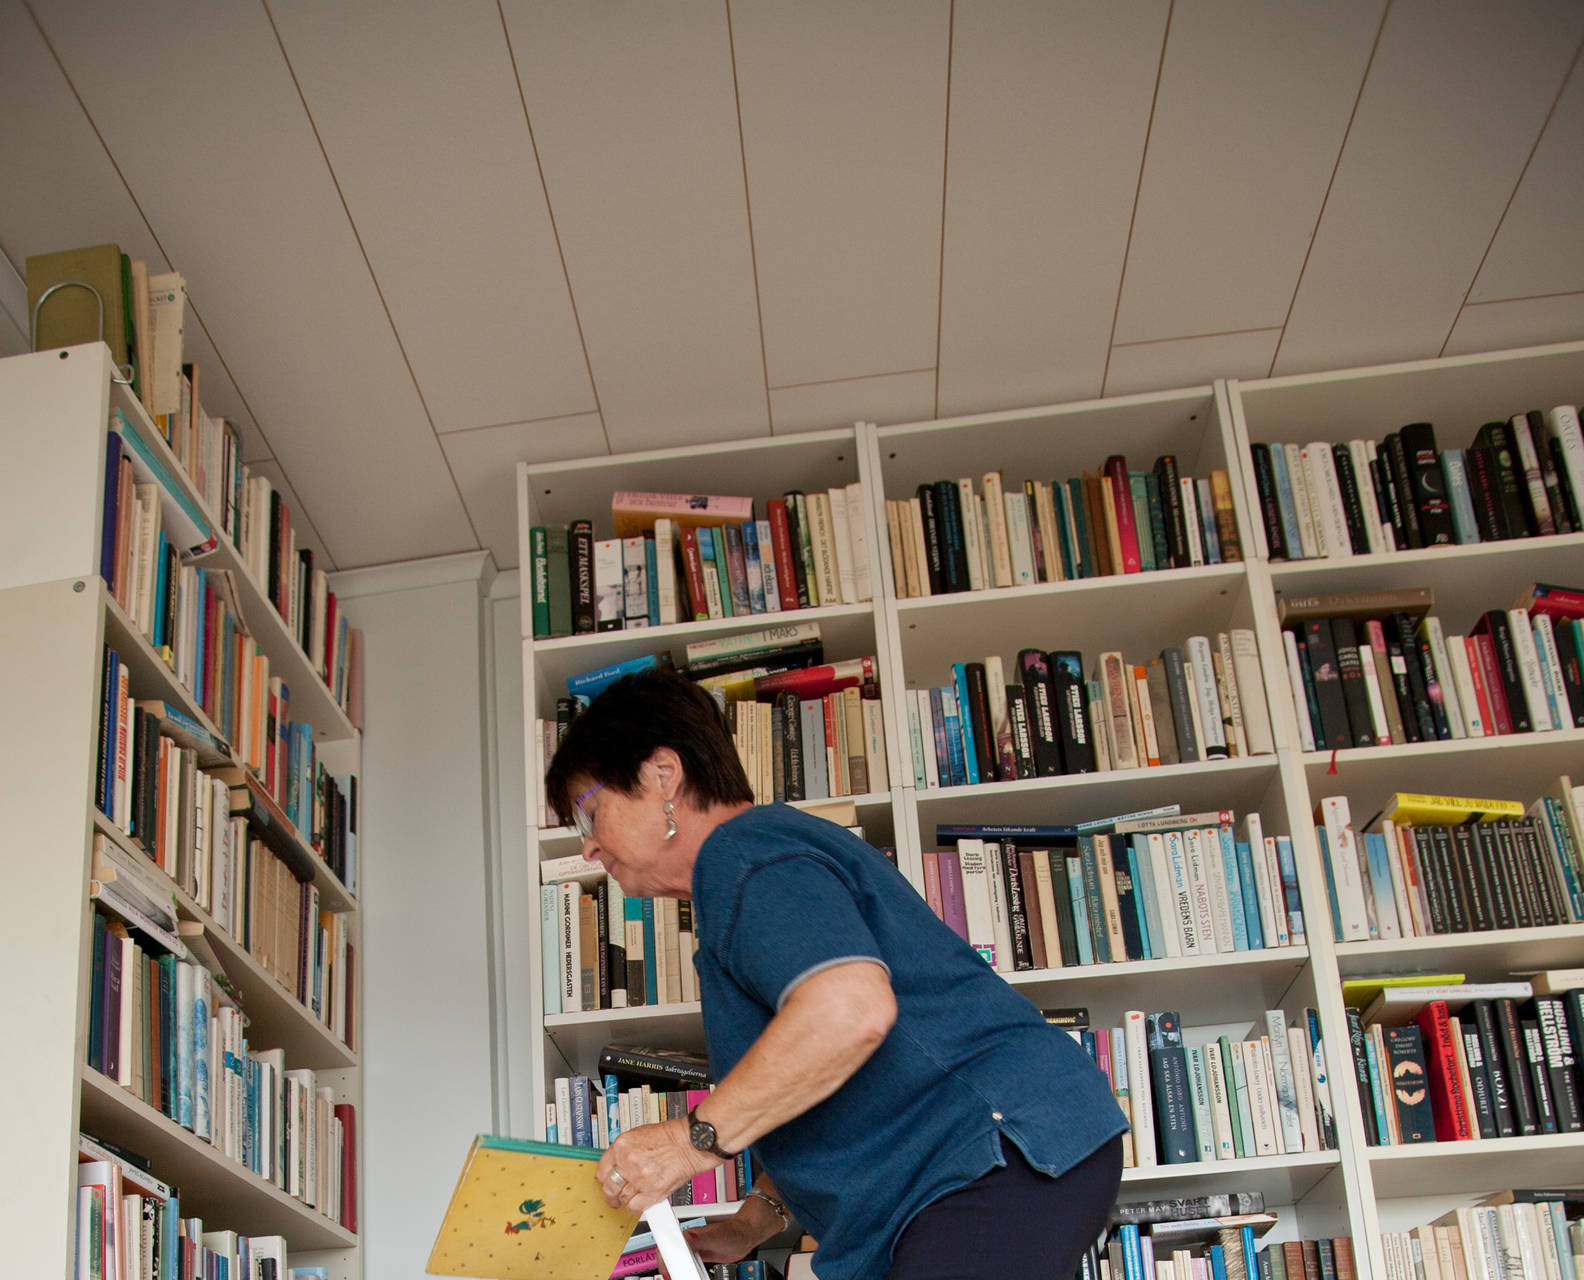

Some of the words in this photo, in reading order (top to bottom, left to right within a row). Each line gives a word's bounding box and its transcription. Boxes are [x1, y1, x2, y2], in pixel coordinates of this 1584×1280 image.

[1177, 891, 1193, 926] VREDENS
[1184, 927, 1196, 948] BARN
[1537, 1000, 1564, 1068] HELLSTRÖM
[1552, 1000, 1573, 1054] ROSLUND
[1563, 1056, 1575, 1066] &
